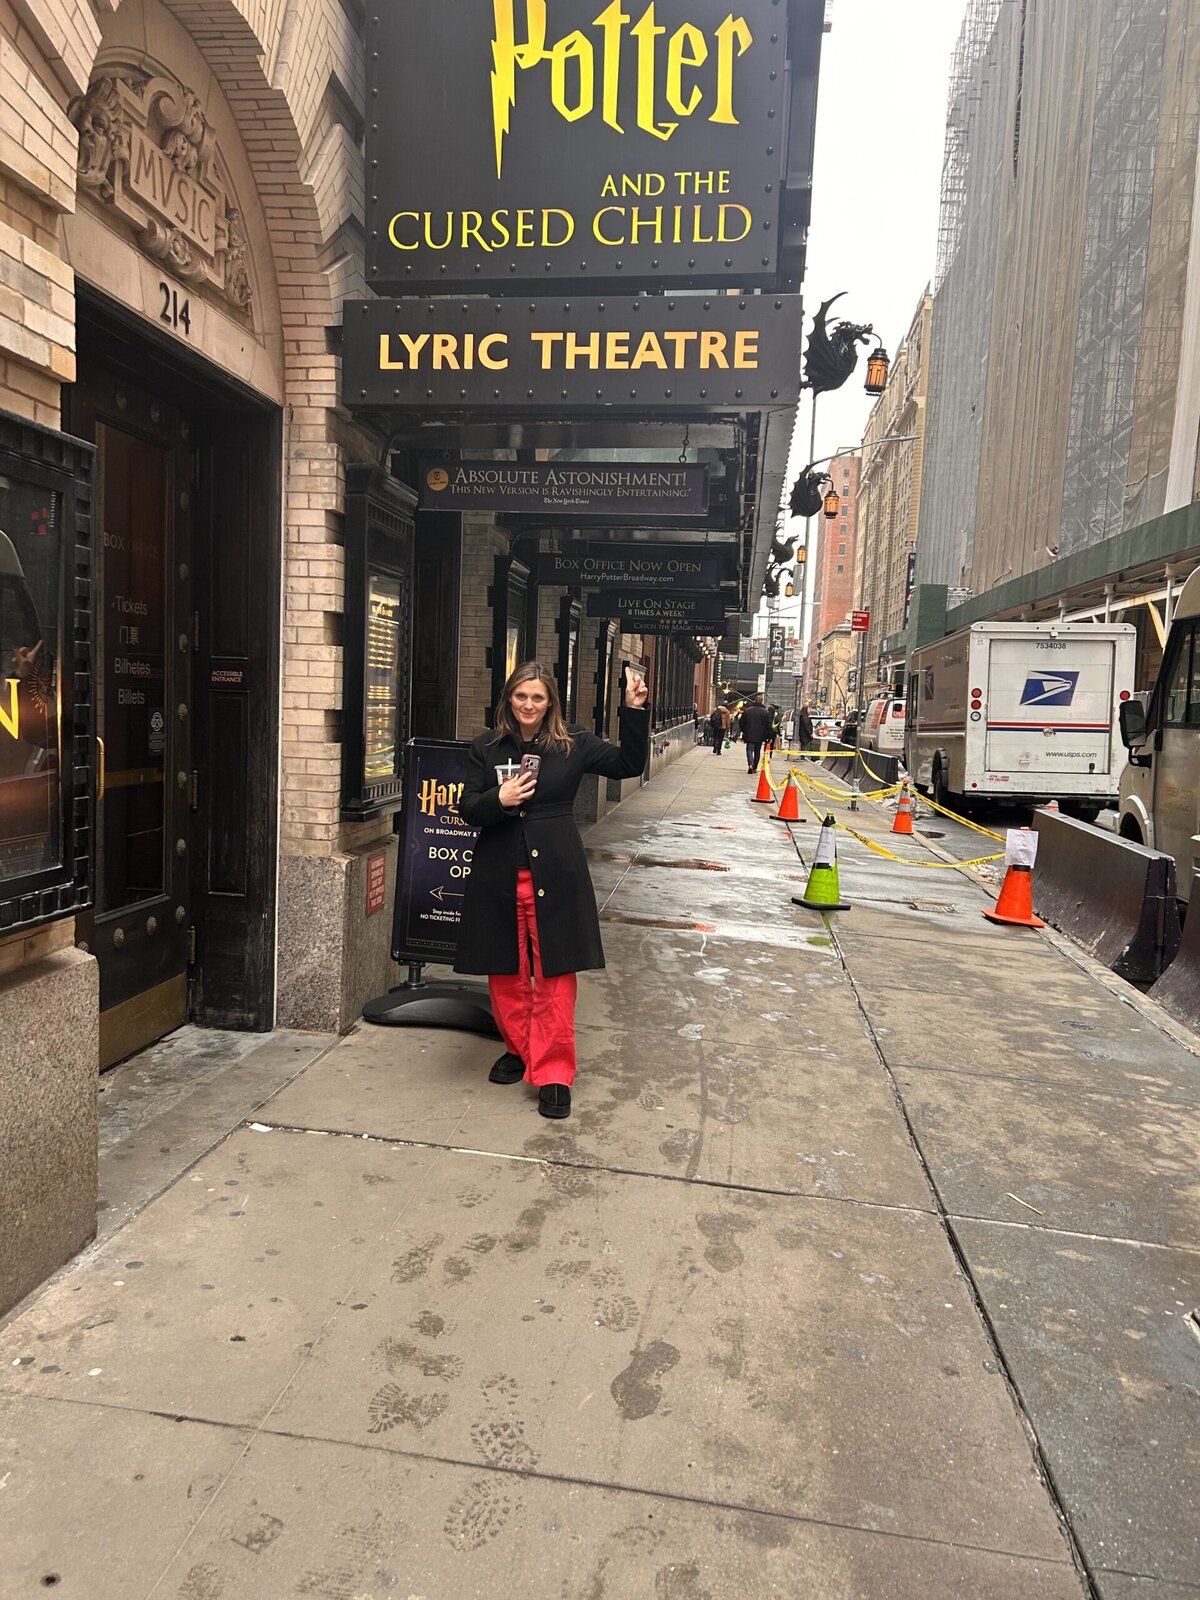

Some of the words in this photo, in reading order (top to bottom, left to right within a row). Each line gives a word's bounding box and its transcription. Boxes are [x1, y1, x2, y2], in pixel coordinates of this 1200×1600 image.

[491, 0, 753, 179] Potter
[134, 137, 211, 244] MVSIC
[601, 174, 666, 197] AND
[674, 171, 731, 195] THE
[388, 208, 575, 252] CURSED
[592, 204, 753, 245] CHILD
[159, 281, 192, 335] 214
[379, 333, 509, 370] LYRIC
[531, 331, 760, 370] THEATRE
[545, 469, 687, 486] ASTONISHMENT!
[450, 484, 471, 494] THIS
[473, 485, 496, 494] NEW
[500, 485, 540, 495] VERSION
[552, 486, 613, 497] RAVISHINGLY
[555, 557, 579, 570] BOX
[583, 558, 625, 571] OFFICE
[629, 560, 663, 572] NOW
[667, 560, 702, 573] OPEN
[580, 572, 674, 584] HarryPotterBroadway.com
[115, 594, 149, 616] Tickets
[618, 597, 640, 608] LIVE
[643, 598, 662, 609] ON
[664, 599, 697, 610] STAGE
[634, 608, 655, 616] TIMES
[662, 609, 685, 617] WEEK!
[633, 622, 657, 630] CATCH
[671, 623, 693, 631] MAGIC
[1035, 642, 1067, 650] 7534038
[114, 657, 152, 675] Bilhetes
[118, 688, 146, 705] Billets
[1045, 750, 1098, 759] www.usps.com
[417, 778, 465, 817] Harr
[440, 815, 469, 826] CURS
[424, 827, 435, 835] ON
[436, 828, 472, 837] BROADWAY
[428, 846, 459, 862] BOX
[449, 865, 472, 879] OP
[420, 913, 429, 921] NO
[429, 914, 455, 922] TICKETING
